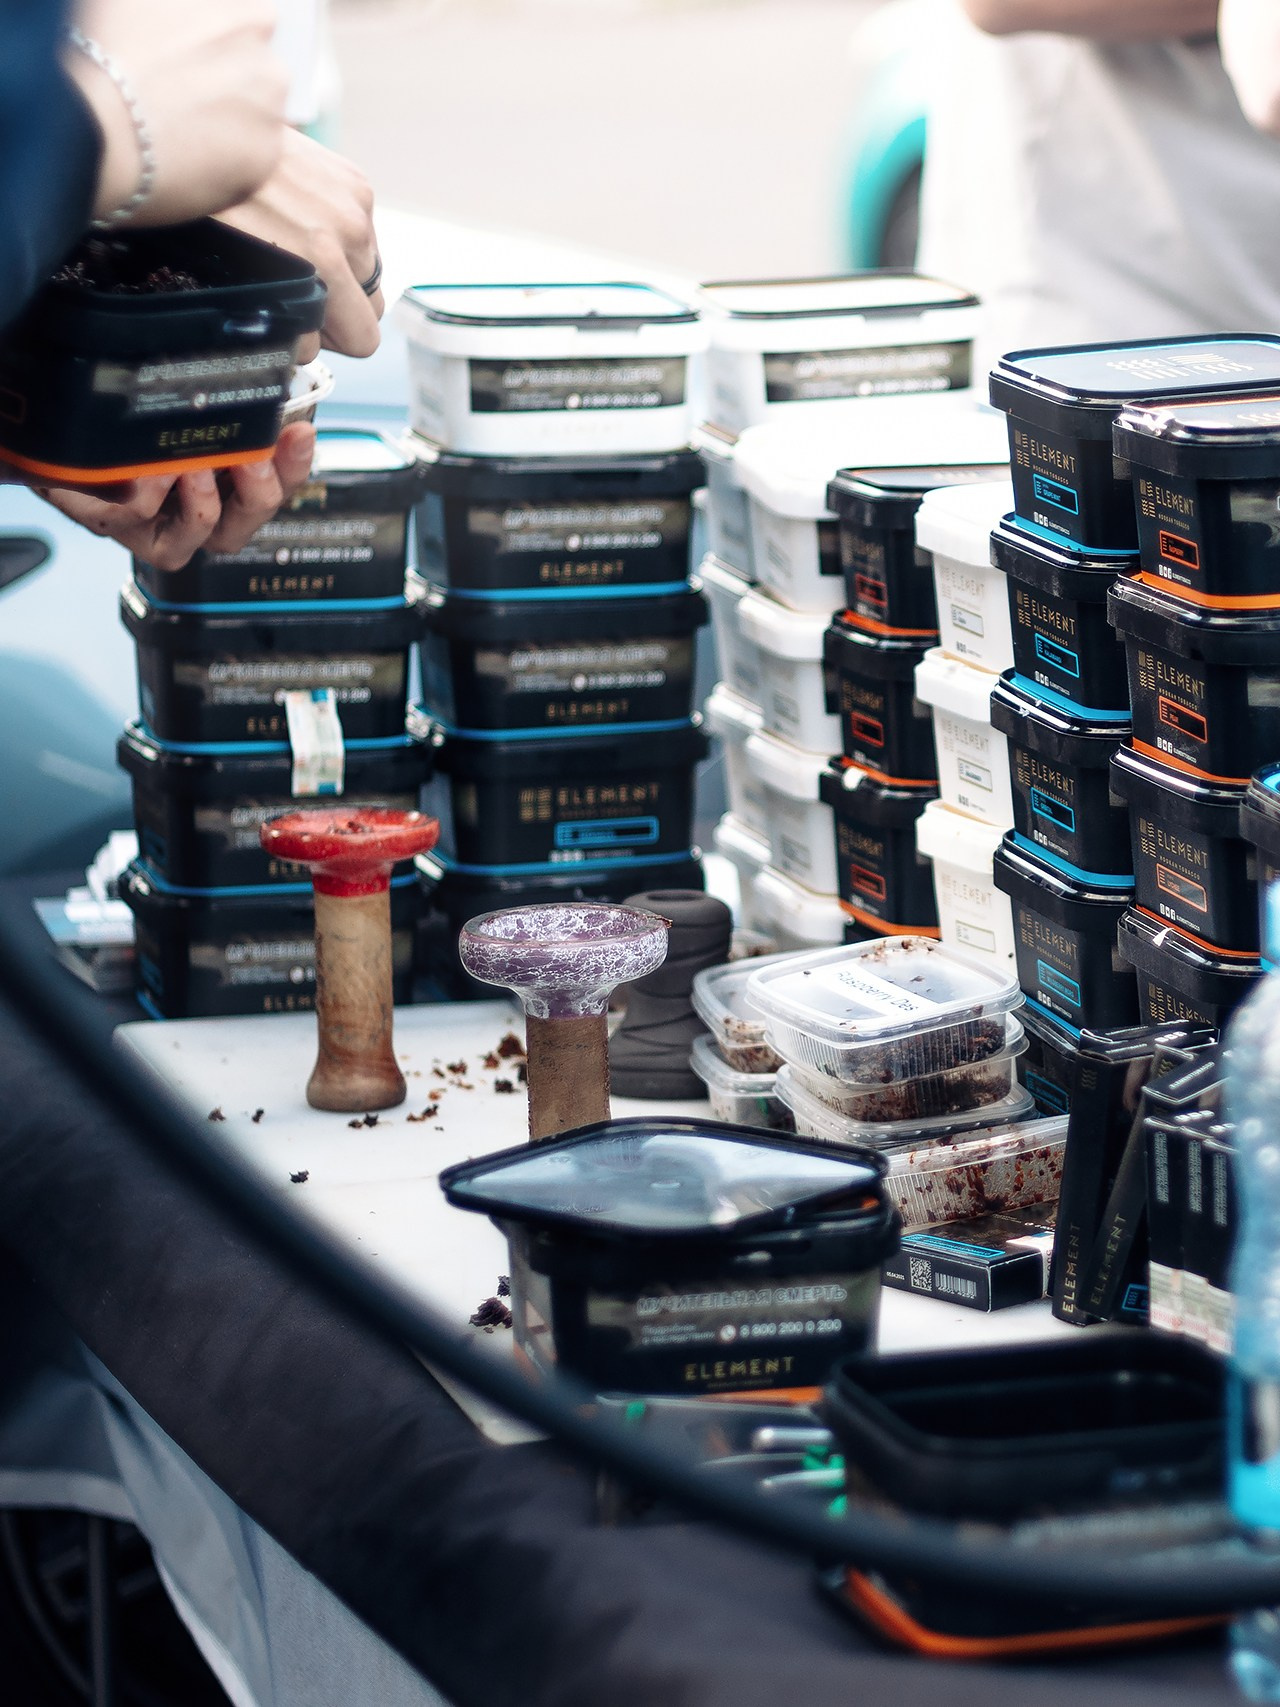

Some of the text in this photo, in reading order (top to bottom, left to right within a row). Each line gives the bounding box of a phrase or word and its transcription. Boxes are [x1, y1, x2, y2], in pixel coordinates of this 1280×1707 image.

[158, 423, 242, 447] ELEMENT
[1030, 439, 1076, 474] ELEMENT
[1155, 486, 1194, 517] ELEMENT
[1032, 599, 1076, 635] ELEMENT
[1156, 660, 1205, 699] ELEMENT
[1031, 759, 1075, 796] ELEMENT
[1157, 829, 1208, 870] ELEMENT
[1034, 921, 1077, 960] ELEMENT
[1062, 1222, 1081, 1313] ELEMENT
[1090, 1213, 1126, 1305] ELEMENT
[778, 1321, 803, 1335] 200
[804, 1320, 815, 1333] 0
[816, 1318, 842, 1333] 200
[684, 1356, 794, 1381] ELEMENT
